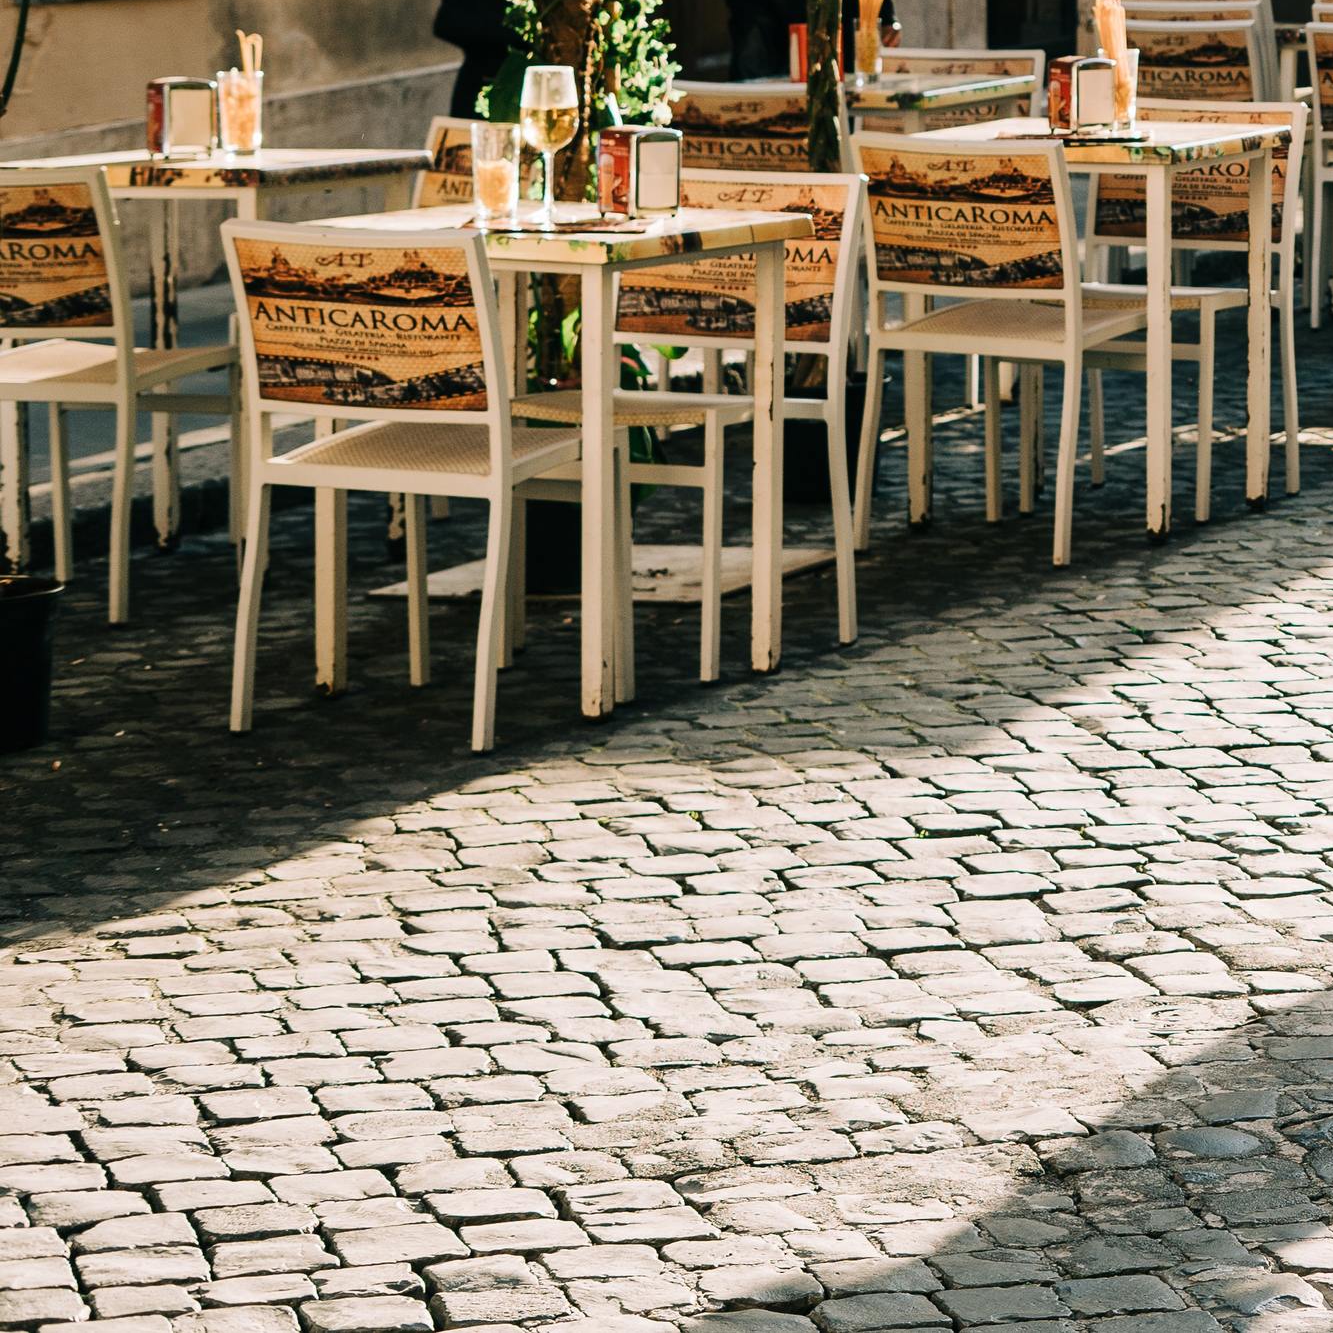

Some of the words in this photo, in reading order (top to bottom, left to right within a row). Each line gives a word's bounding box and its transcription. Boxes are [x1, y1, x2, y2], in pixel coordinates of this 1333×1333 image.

[1139, 69, 1249, 83] TICAROMA
[683, 140, 809, 156] NTICAROM
[875, 200, 1054, 225] ANTICAROMA
[254, 301, 475, 332] ANTICAROMA
